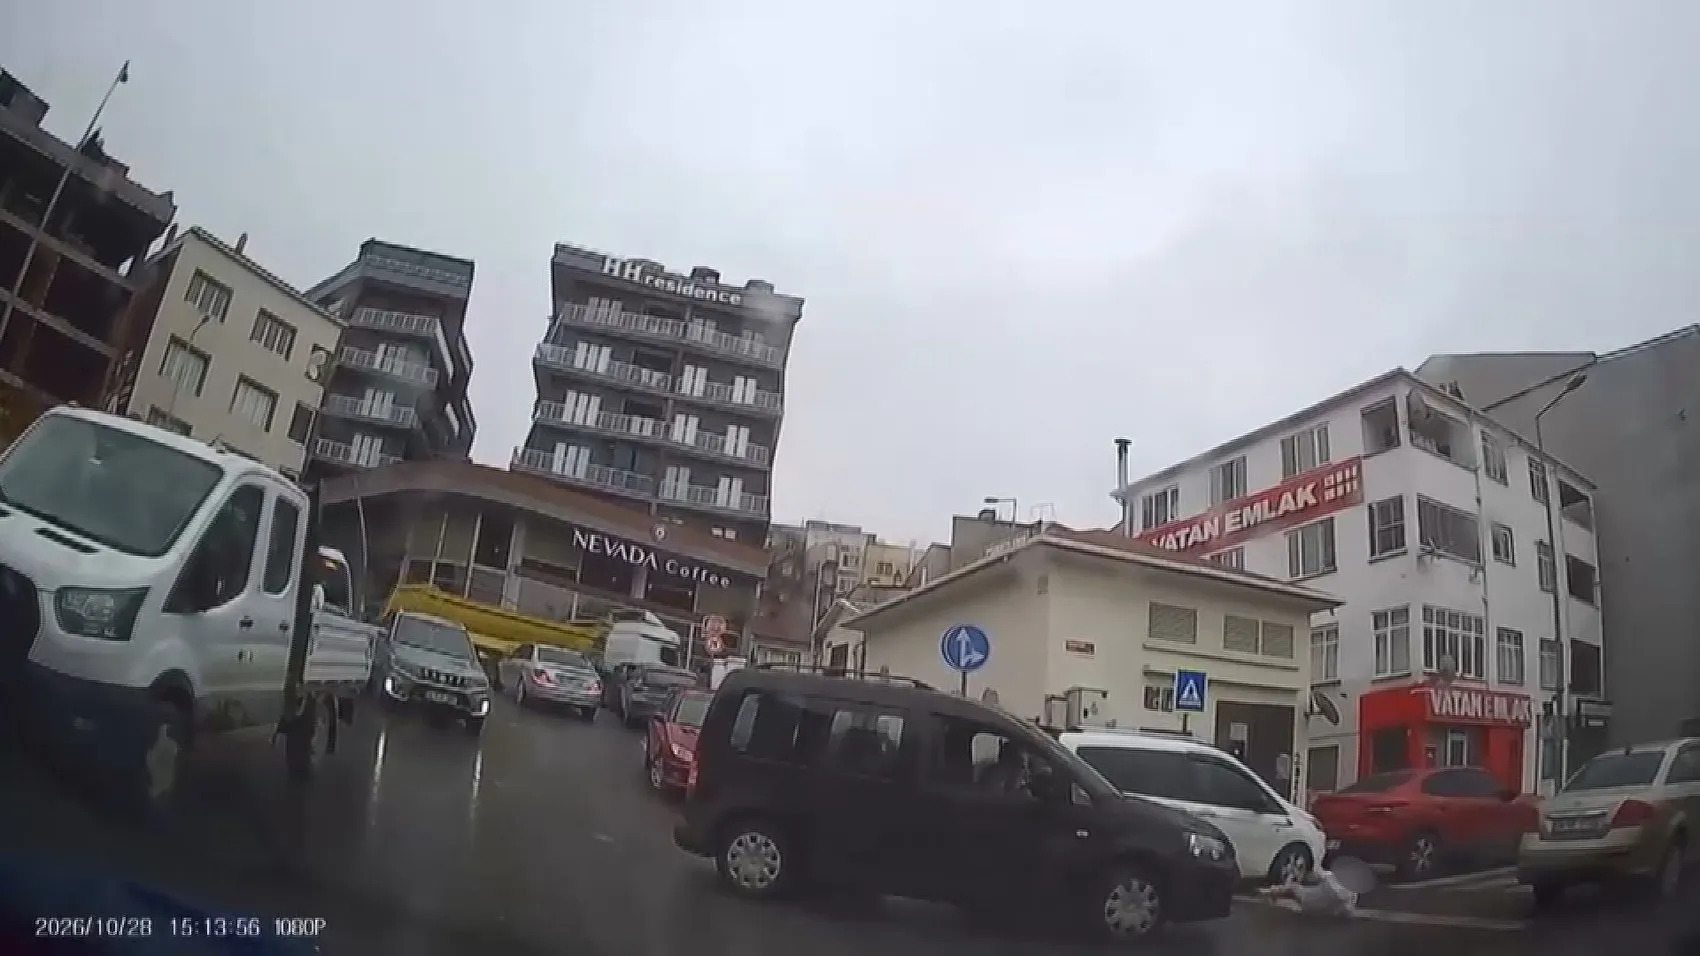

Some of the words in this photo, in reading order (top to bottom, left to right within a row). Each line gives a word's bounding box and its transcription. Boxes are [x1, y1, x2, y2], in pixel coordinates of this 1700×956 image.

[645, 274, 742, 305] residence
[1150, 516, 1220, 551] VATAN
[1224, 481, 1318, 534] EMLAK
[572, 527, 658, 571] NEVADA
[665, 558, 731, 588] Coffee
[1430, 687, 1482, 717] VATAN
